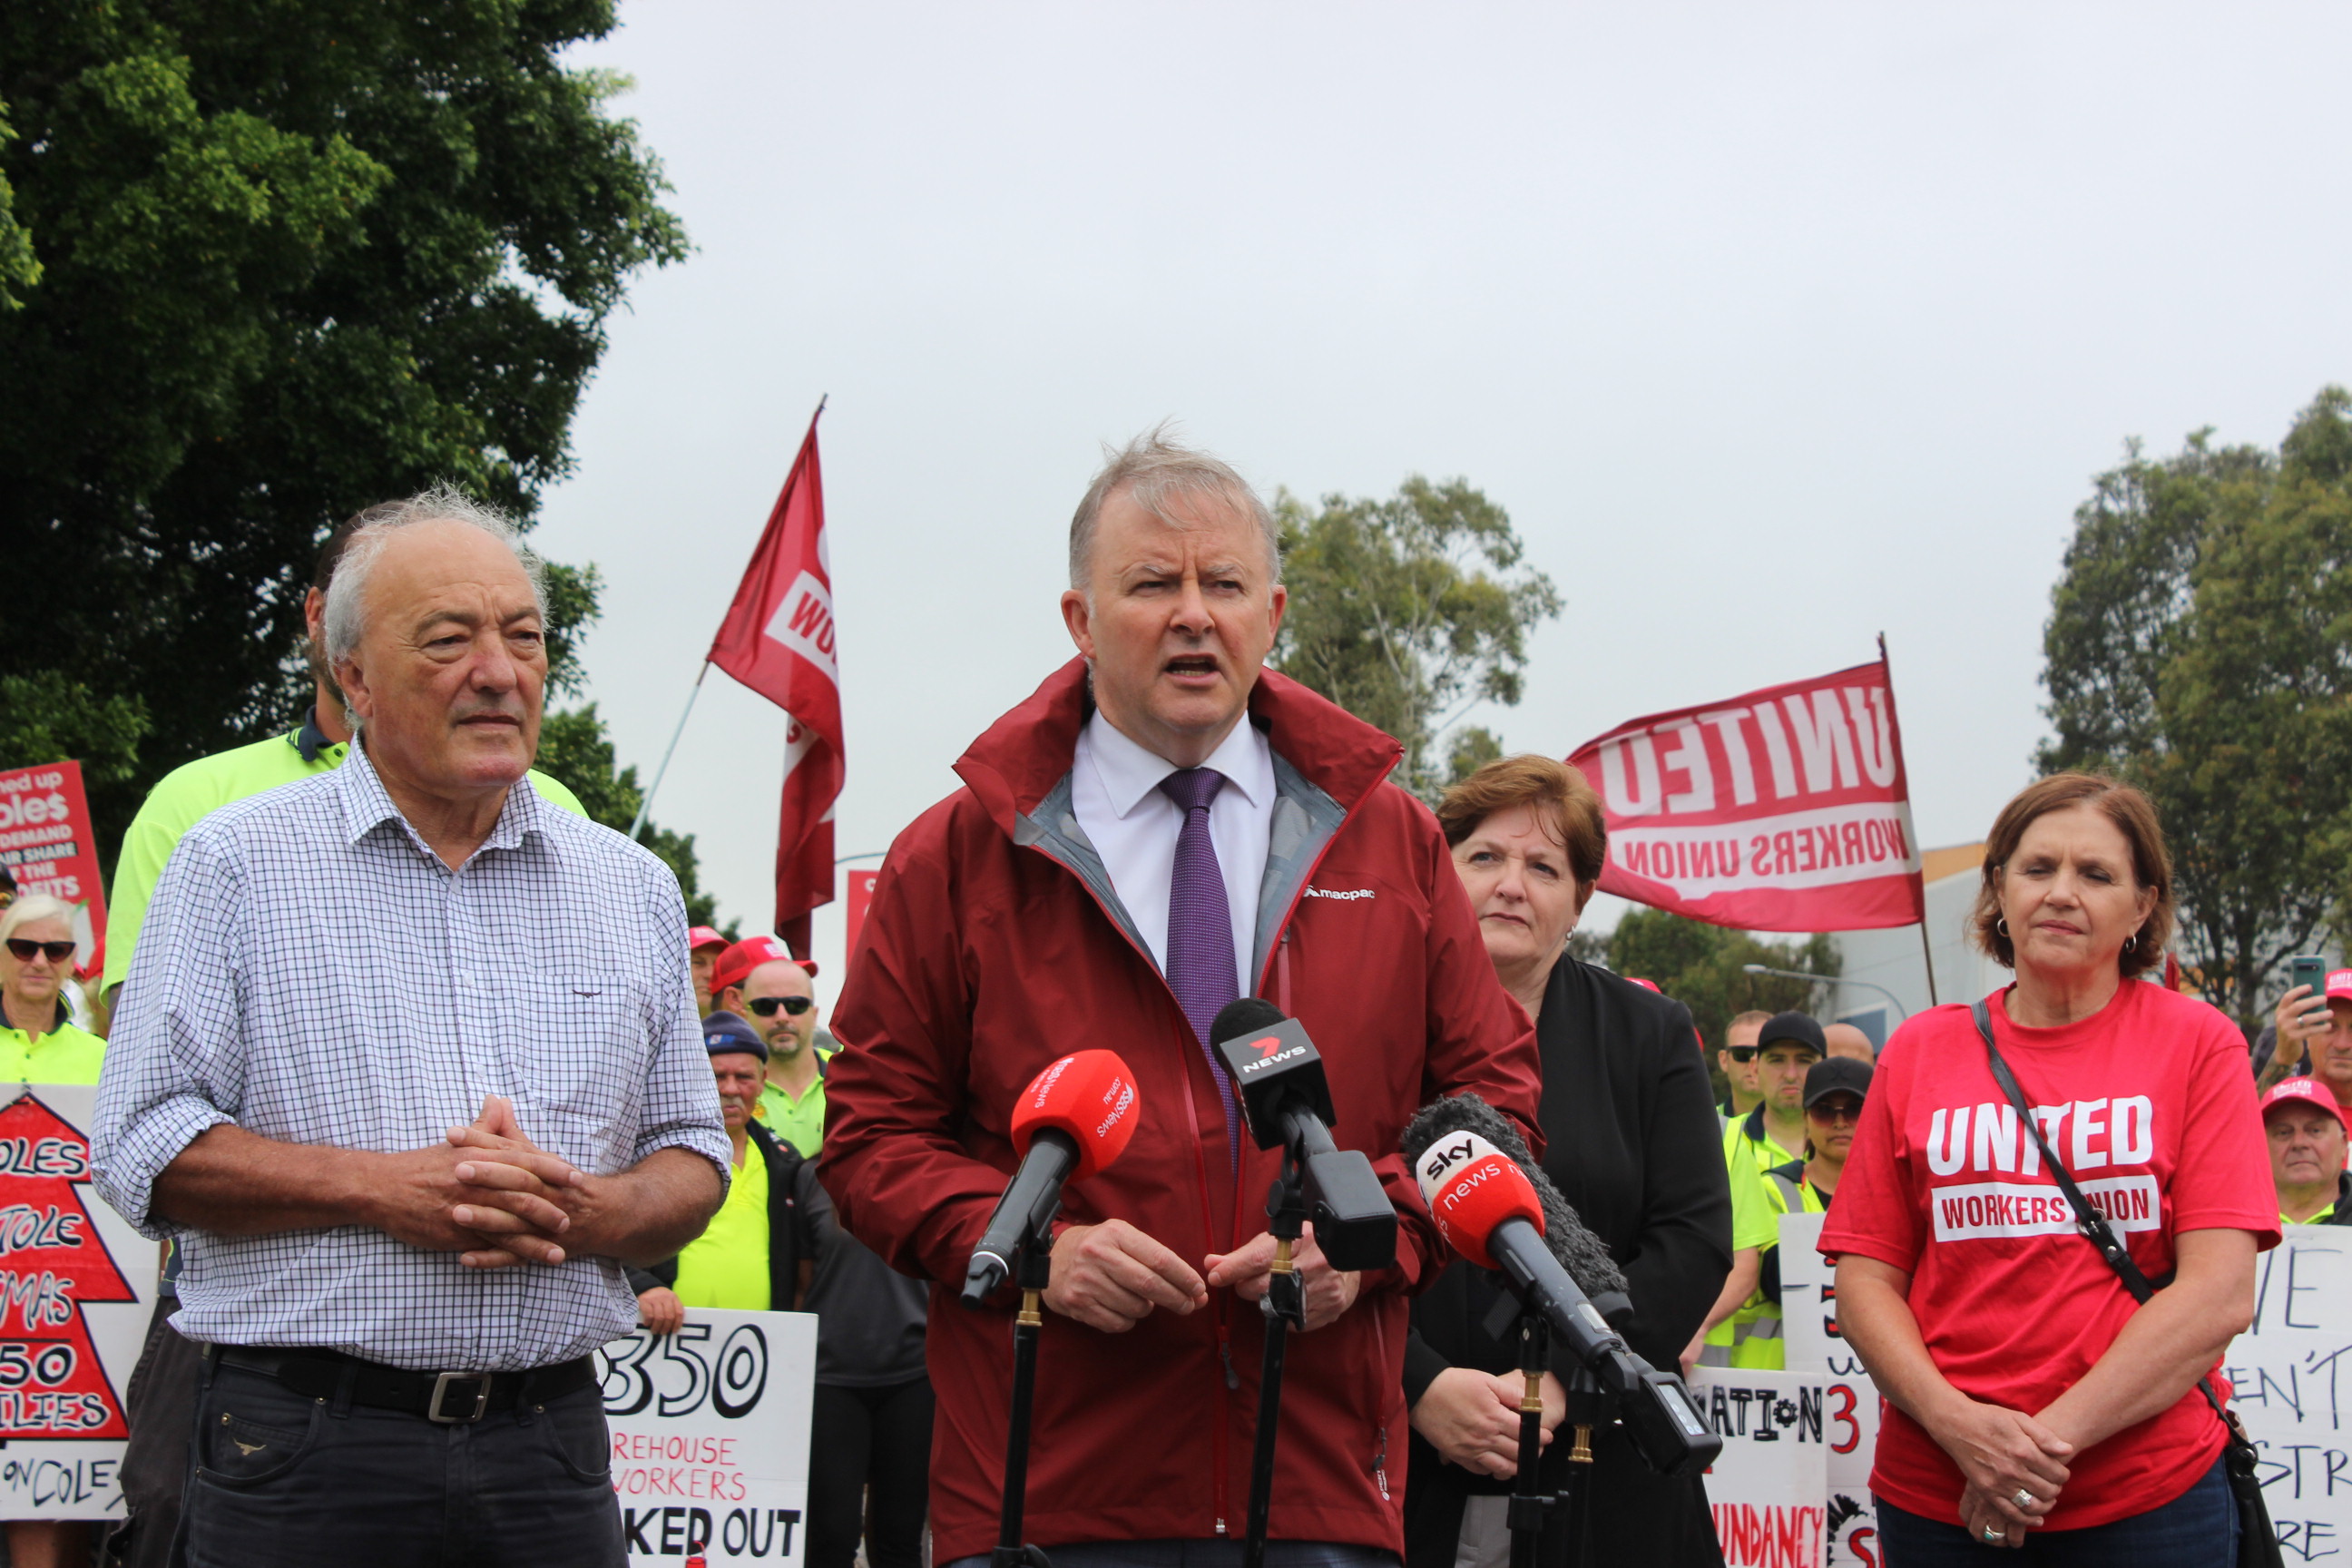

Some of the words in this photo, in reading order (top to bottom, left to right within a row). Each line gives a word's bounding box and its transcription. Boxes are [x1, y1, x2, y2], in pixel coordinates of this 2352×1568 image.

[788, 590, 837, 665] WO
[34, 770, 64, 791] up
[22, 860, 58, 880] THE
[23, 840, 78, 863] SHARE
[1319, 888, 1376, 901] macpac
[1241, 1045, 1307, 1073] NEWS
[1926, 1094, 2154, 1177] UNITED
[1426, 1138, 1474, 1181] sky
[1442, 1162, 1502, 1211] news
[1941, 1192, 2067, 1230] WORKERS
[2075, 1188, 2150, 1221] NION
[602, 1322, 769, 1419] 350
[722, 1507, 802, 1558] OUT
